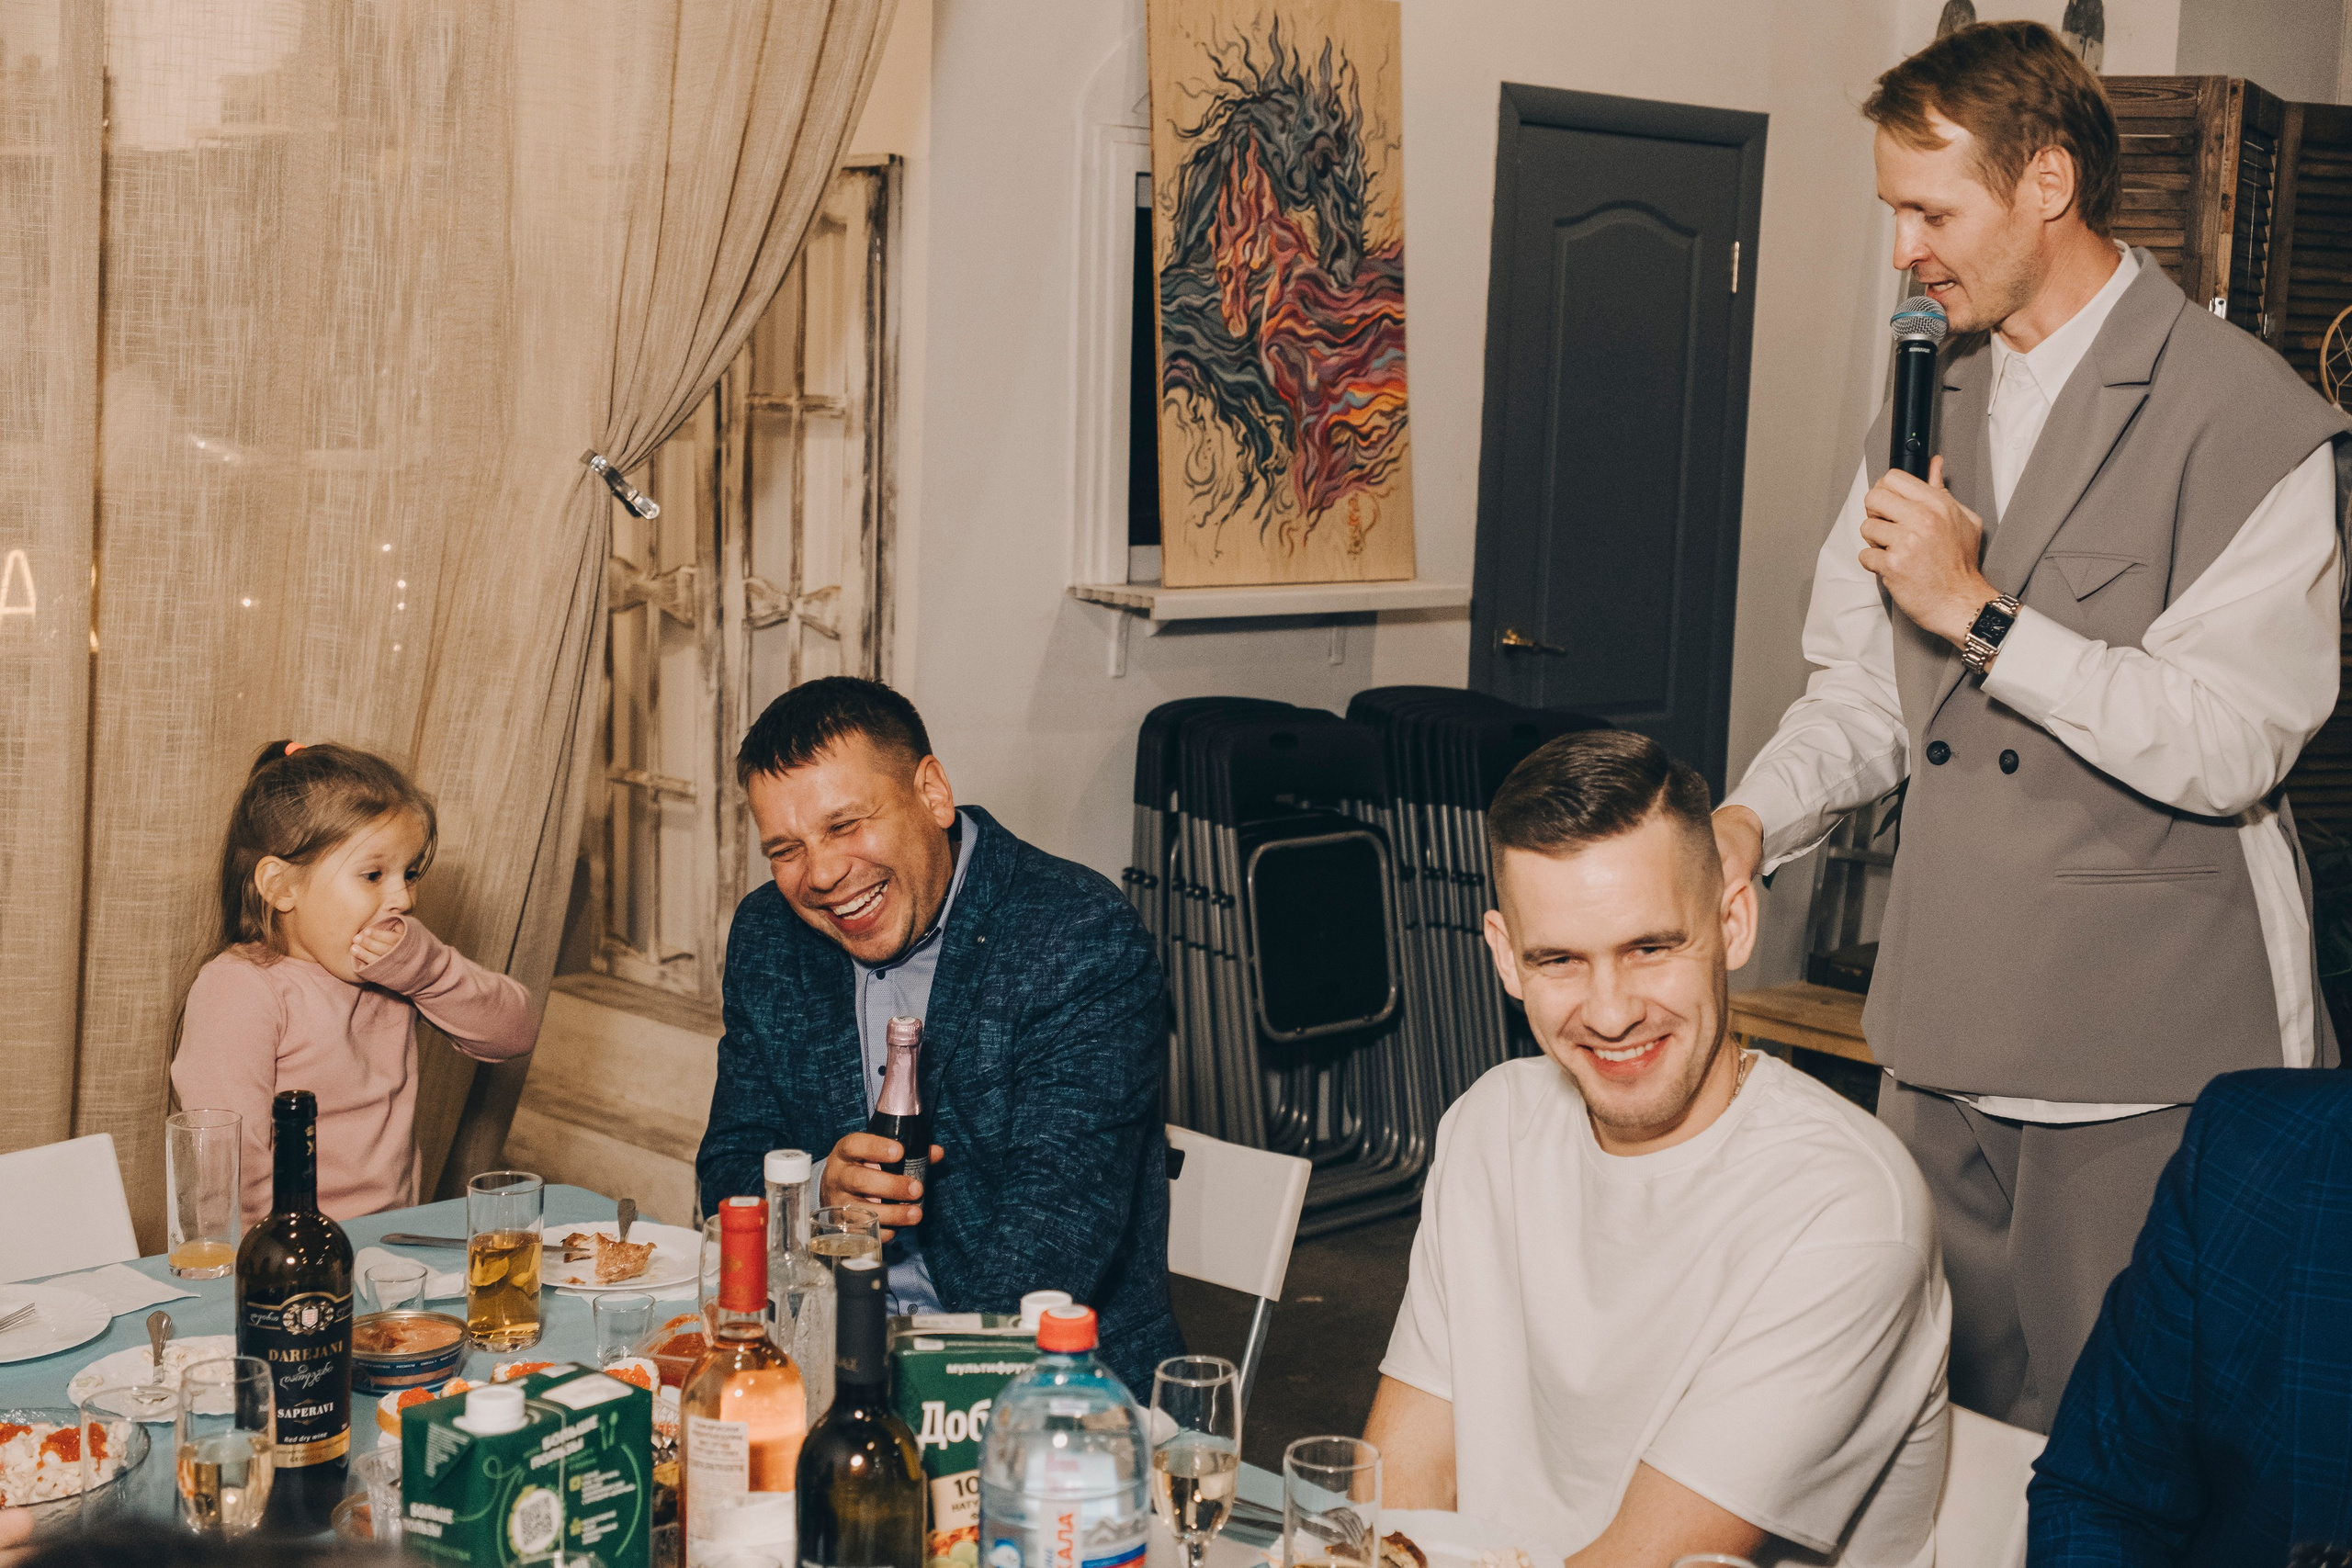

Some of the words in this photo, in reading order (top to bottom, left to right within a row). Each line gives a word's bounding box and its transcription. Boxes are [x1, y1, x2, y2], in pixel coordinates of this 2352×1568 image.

[268, 1340, 344, 1362] DAREJANI
[945, 1361, 1023, 1376] мультифру
[277, 1402, 334, 1418] SAPERAVI
[284, 1435, 298, 1443] Red
[299, 1435, 311, 1443] dry
[312, 1432, 328, 1440] wine
